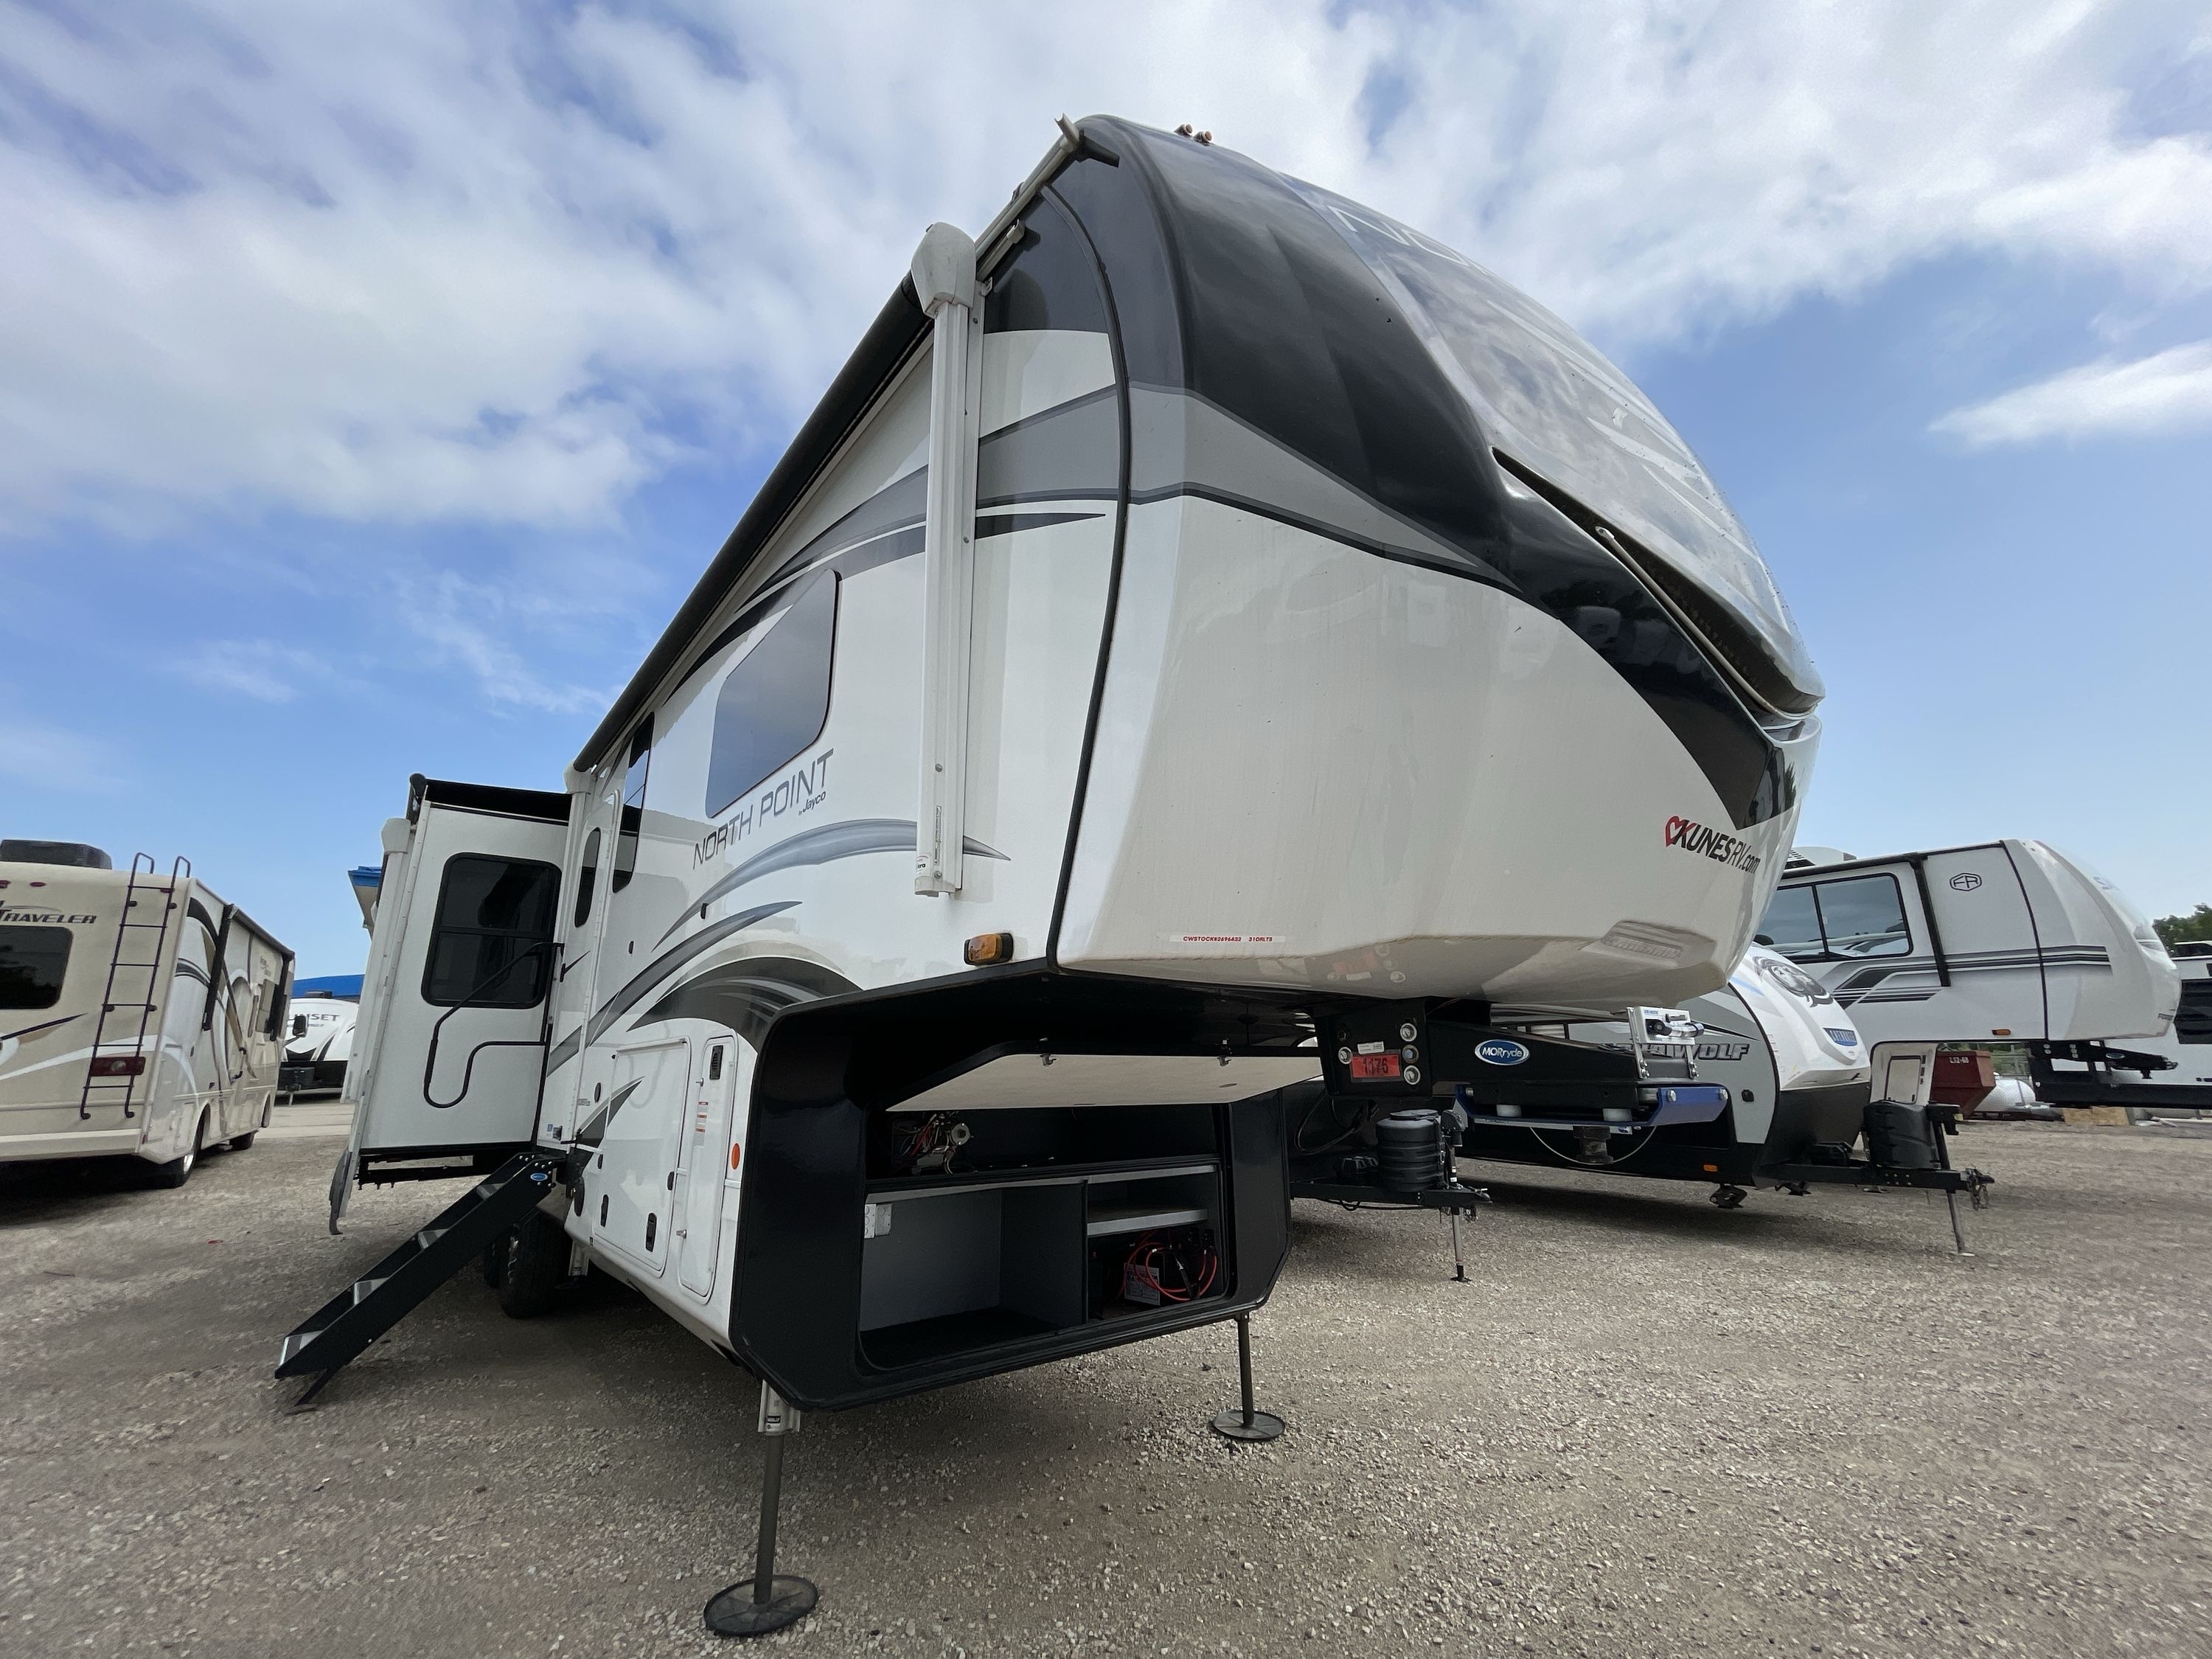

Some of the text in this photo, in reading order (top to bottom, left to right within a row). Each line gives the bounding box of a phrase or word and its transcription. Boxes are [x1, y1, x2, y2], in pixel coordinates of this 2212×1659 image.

[692, 748, 835, 870] NORTH POINT
[802, 790, 827, 813] Jayco
[1481, 1047, 1523, 1058] MORryde
